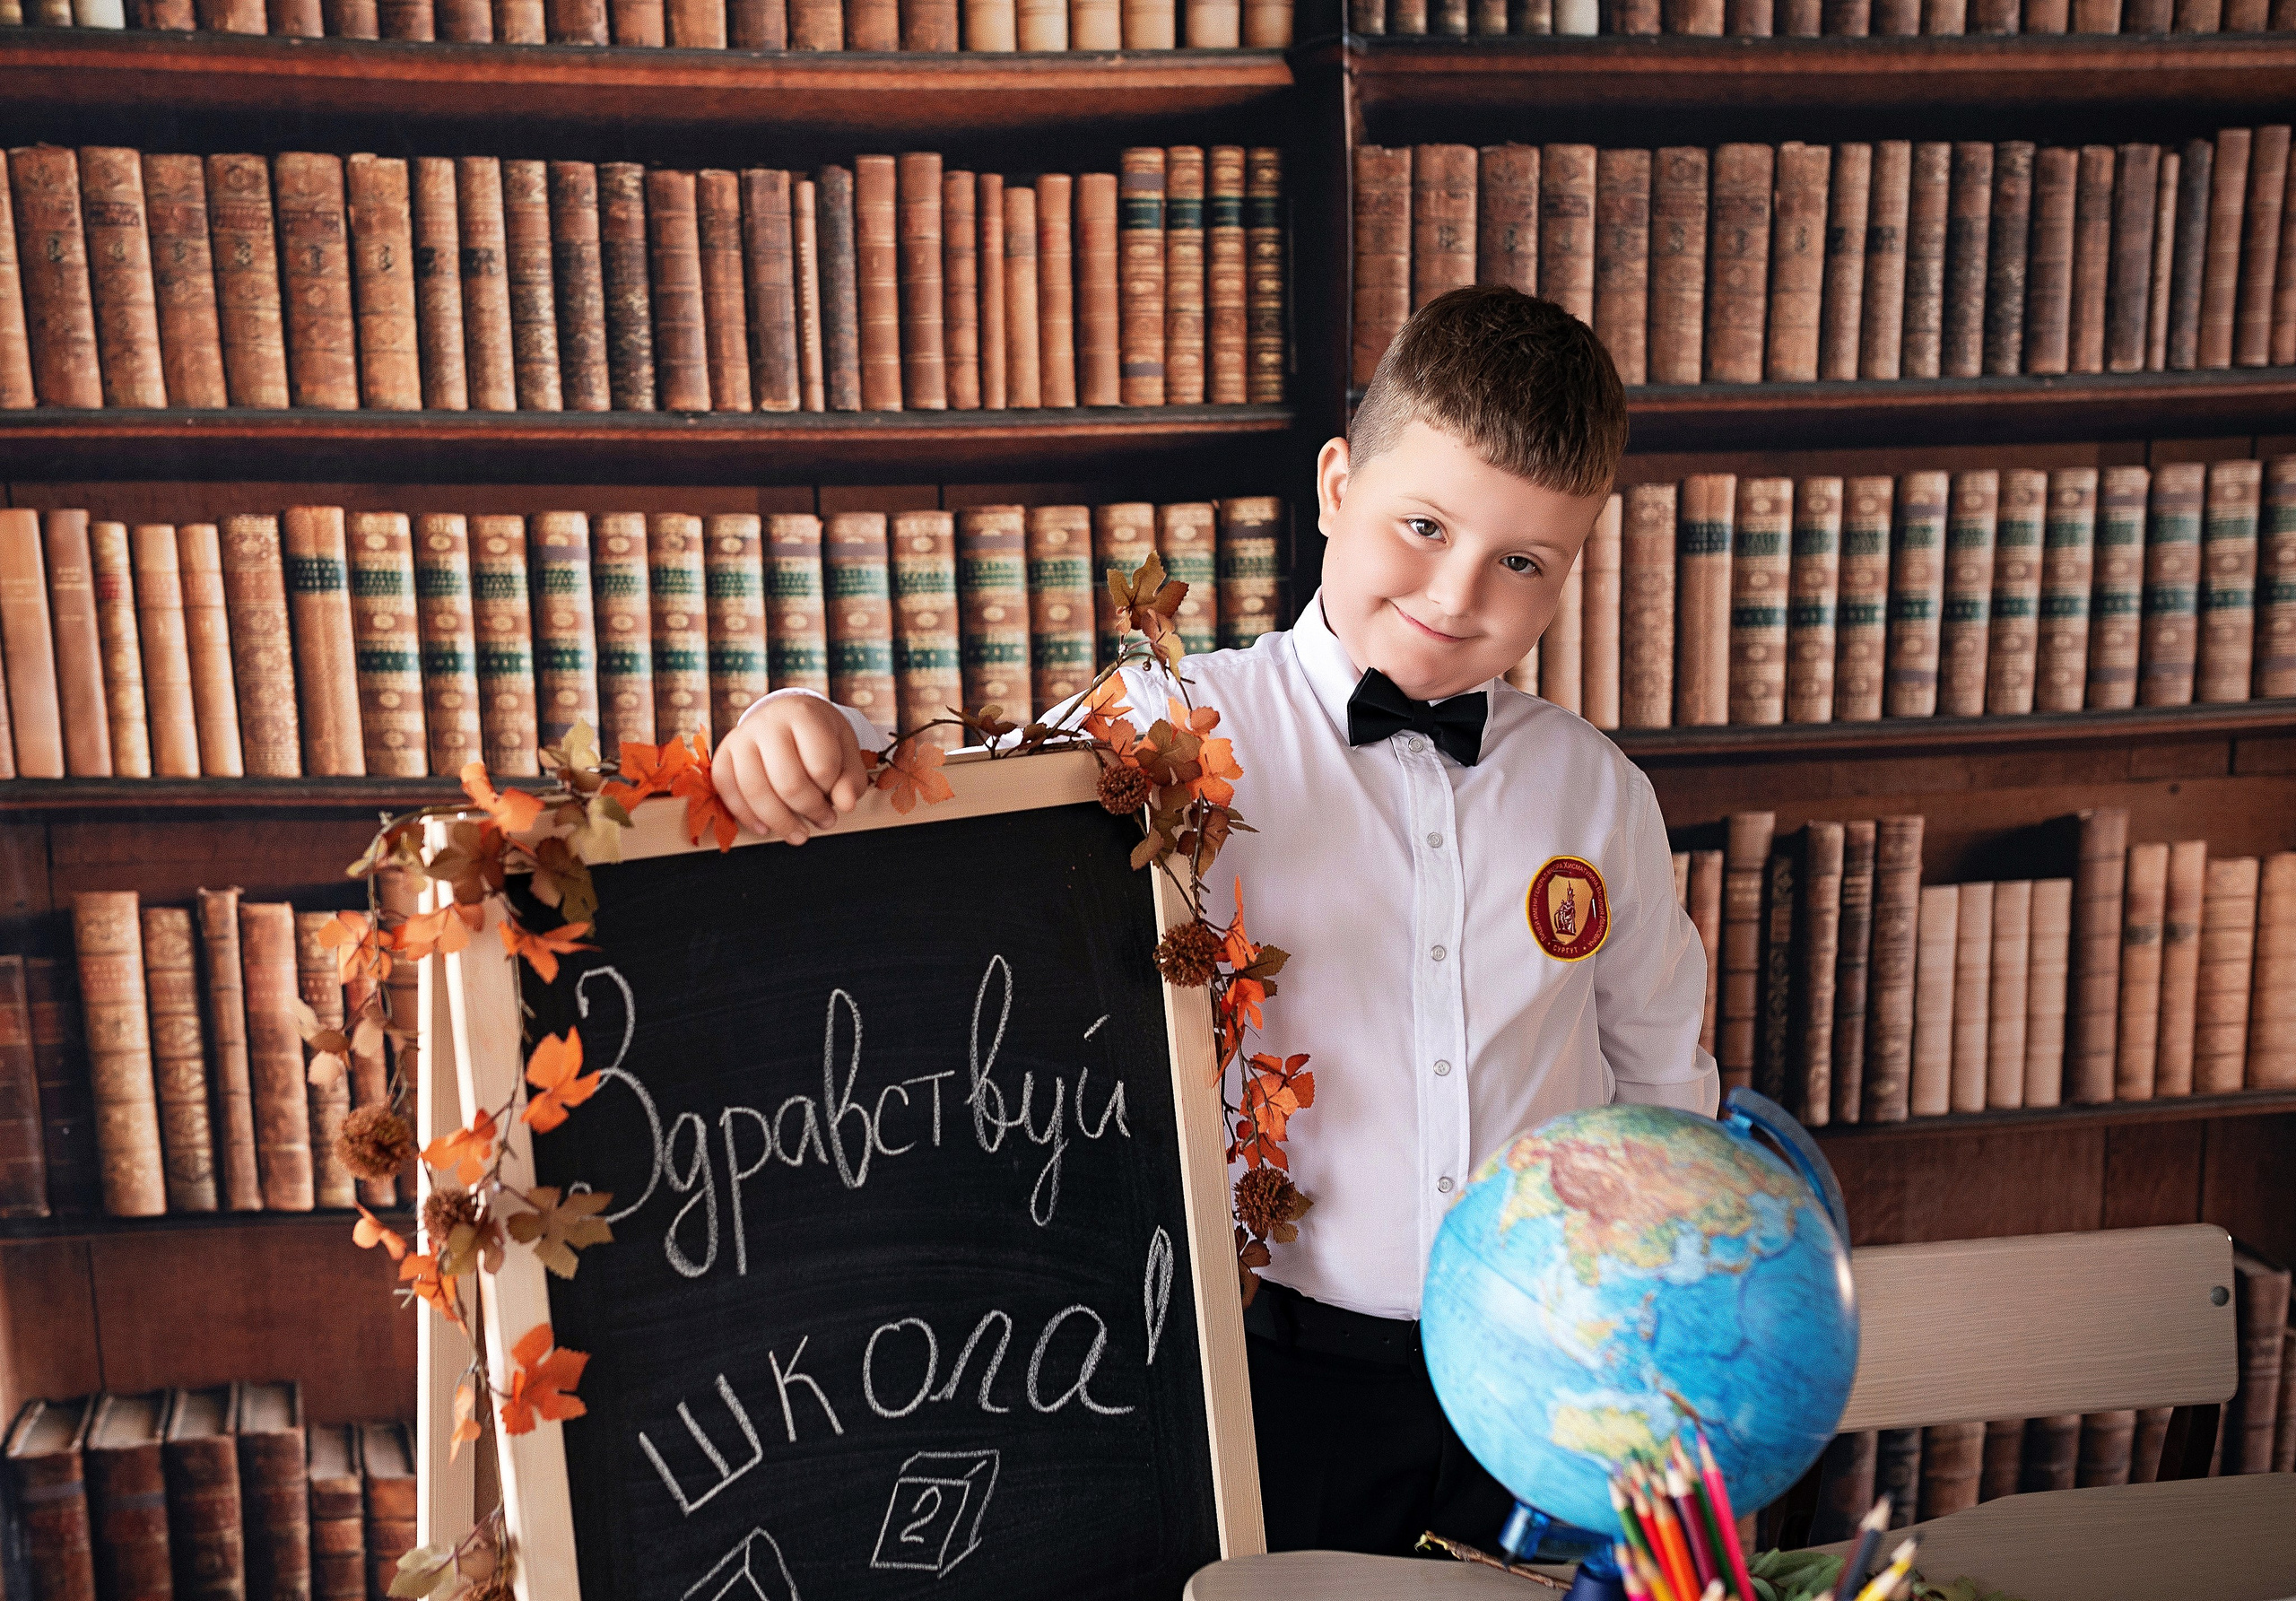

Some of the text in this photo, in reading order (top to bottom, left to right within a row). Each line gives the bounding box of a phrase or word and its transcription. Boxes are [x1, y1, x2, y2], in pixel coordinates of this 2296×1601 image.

[1552, 944, 1578, 953] СУРГУТ
[569, 953, 1131, 1277] Здравствуй
[900, 1484, 943, 1543] 2
